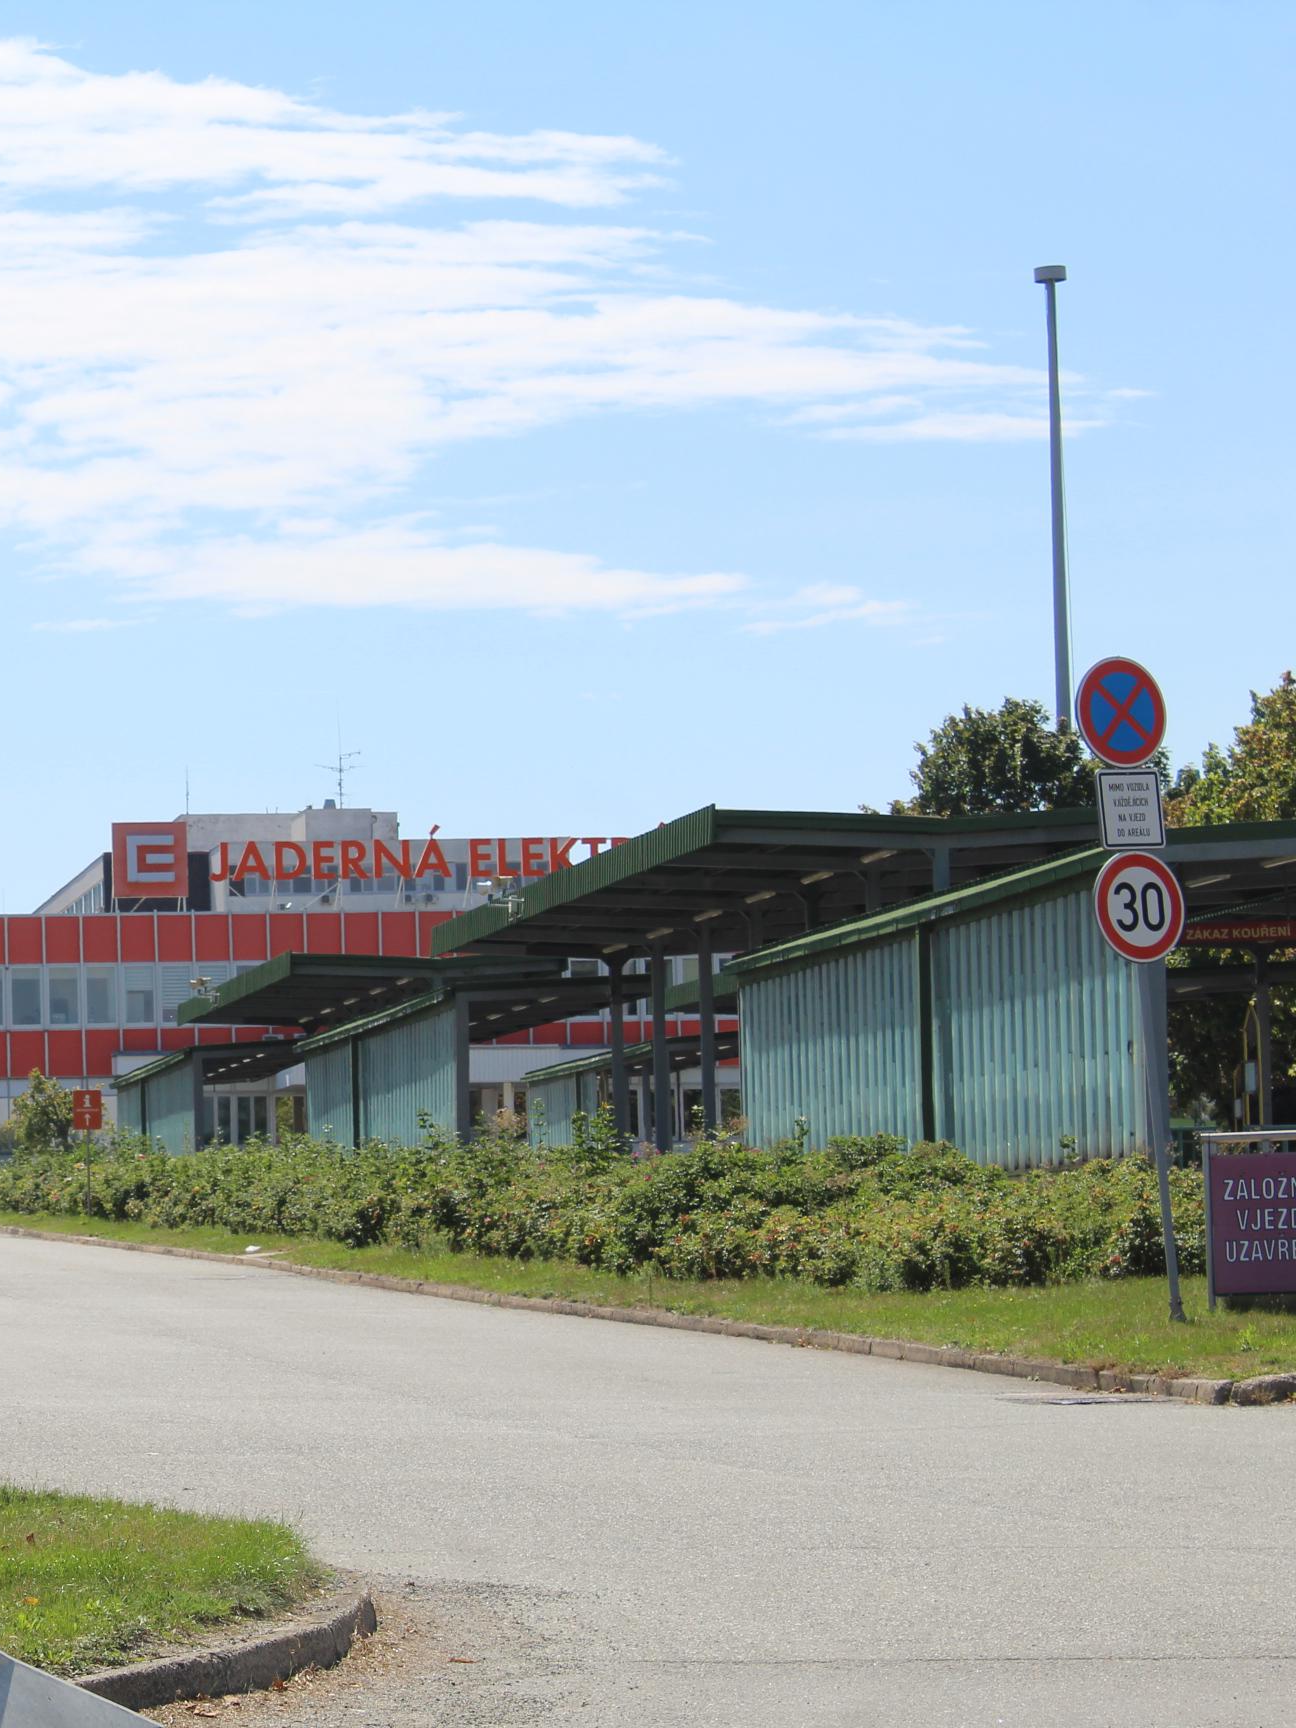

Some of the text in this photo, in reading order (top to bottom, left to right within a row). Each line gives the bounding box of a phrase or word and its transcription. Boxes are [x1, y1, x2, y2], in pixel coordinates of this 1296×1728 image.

[1118, 813, 1146, 822] NA VJEZD
[1117, 829, 1126, 837] DO
[209, 824, 632, 882] JADERNÁ ELEKT
[1114, 882, 1165, 932] 30
